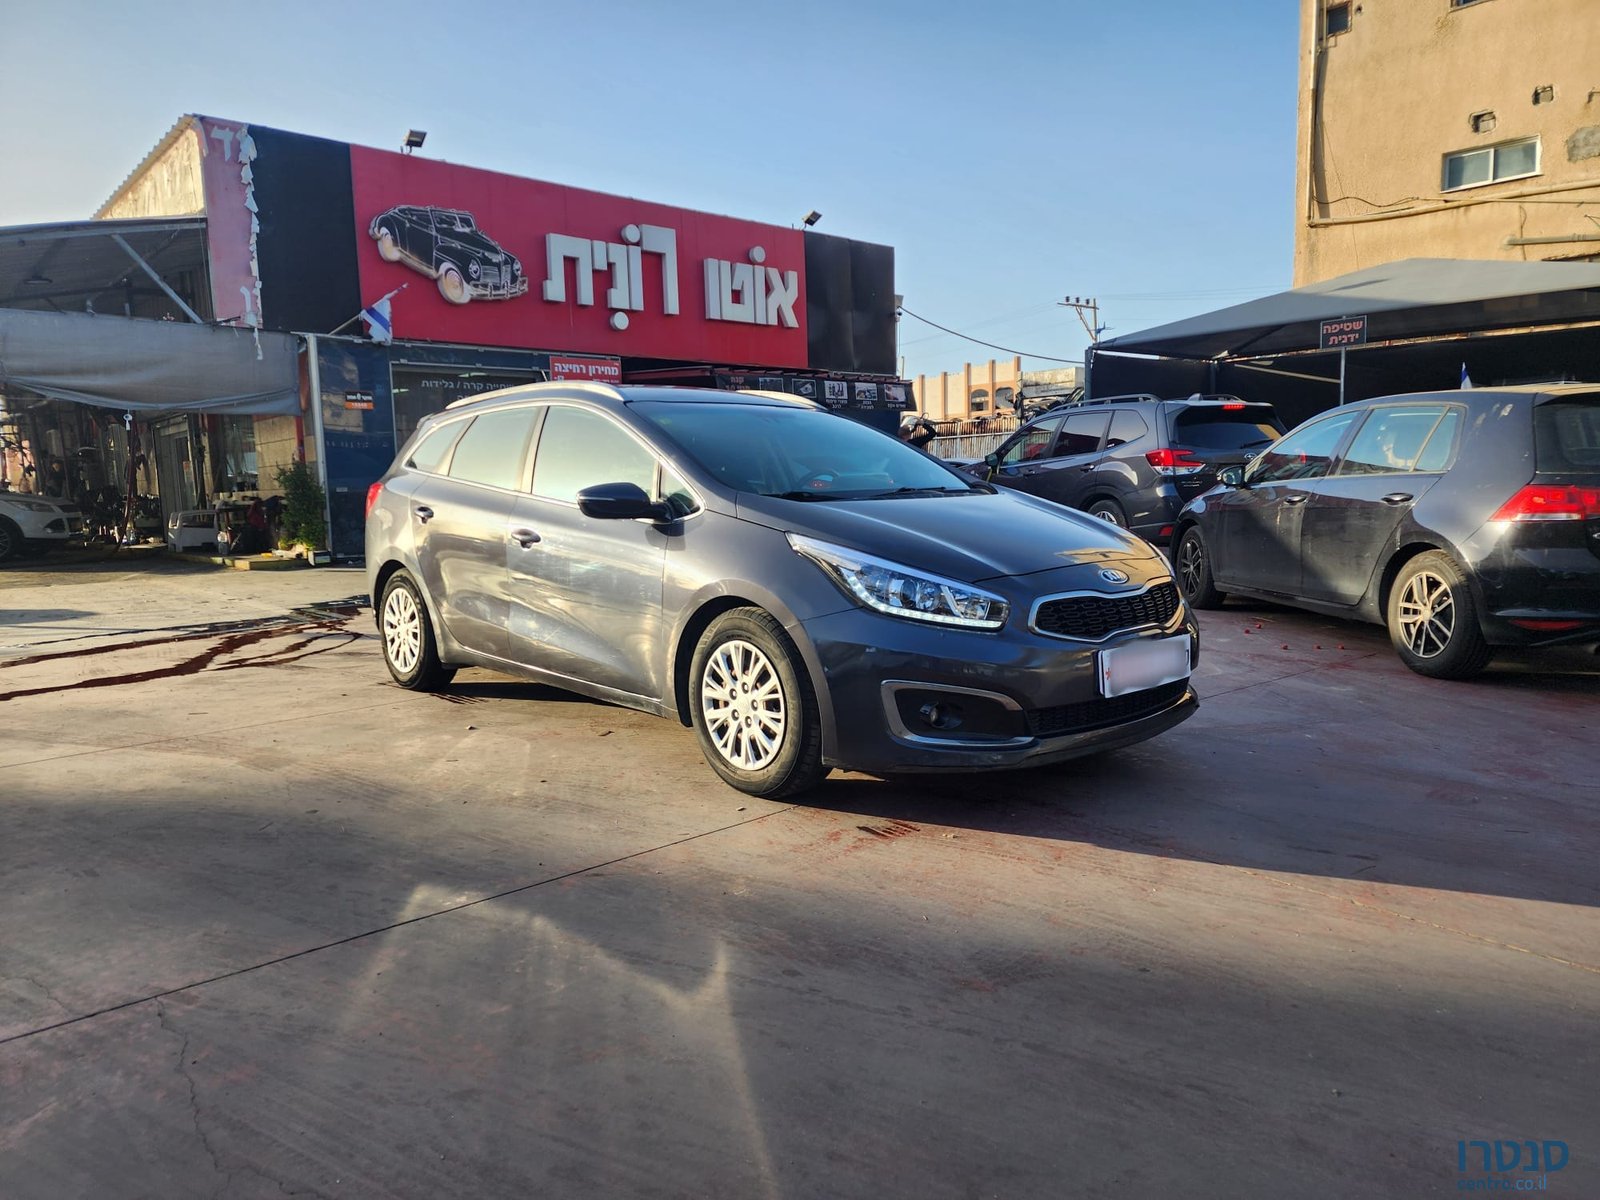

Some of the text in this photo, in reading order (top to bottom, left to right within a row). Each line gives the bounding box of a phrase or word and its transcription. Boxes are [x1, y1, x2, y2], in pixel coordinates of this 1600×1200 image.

[1323, 320, 1363, 334] שטיפה
[1329, 333, 1359, 345] ידנית
[554, 362, 619, 376] מחירון רחיצה
[421, 380, 454, 389] גלידות
[463, 382, 484, 391] קרה
